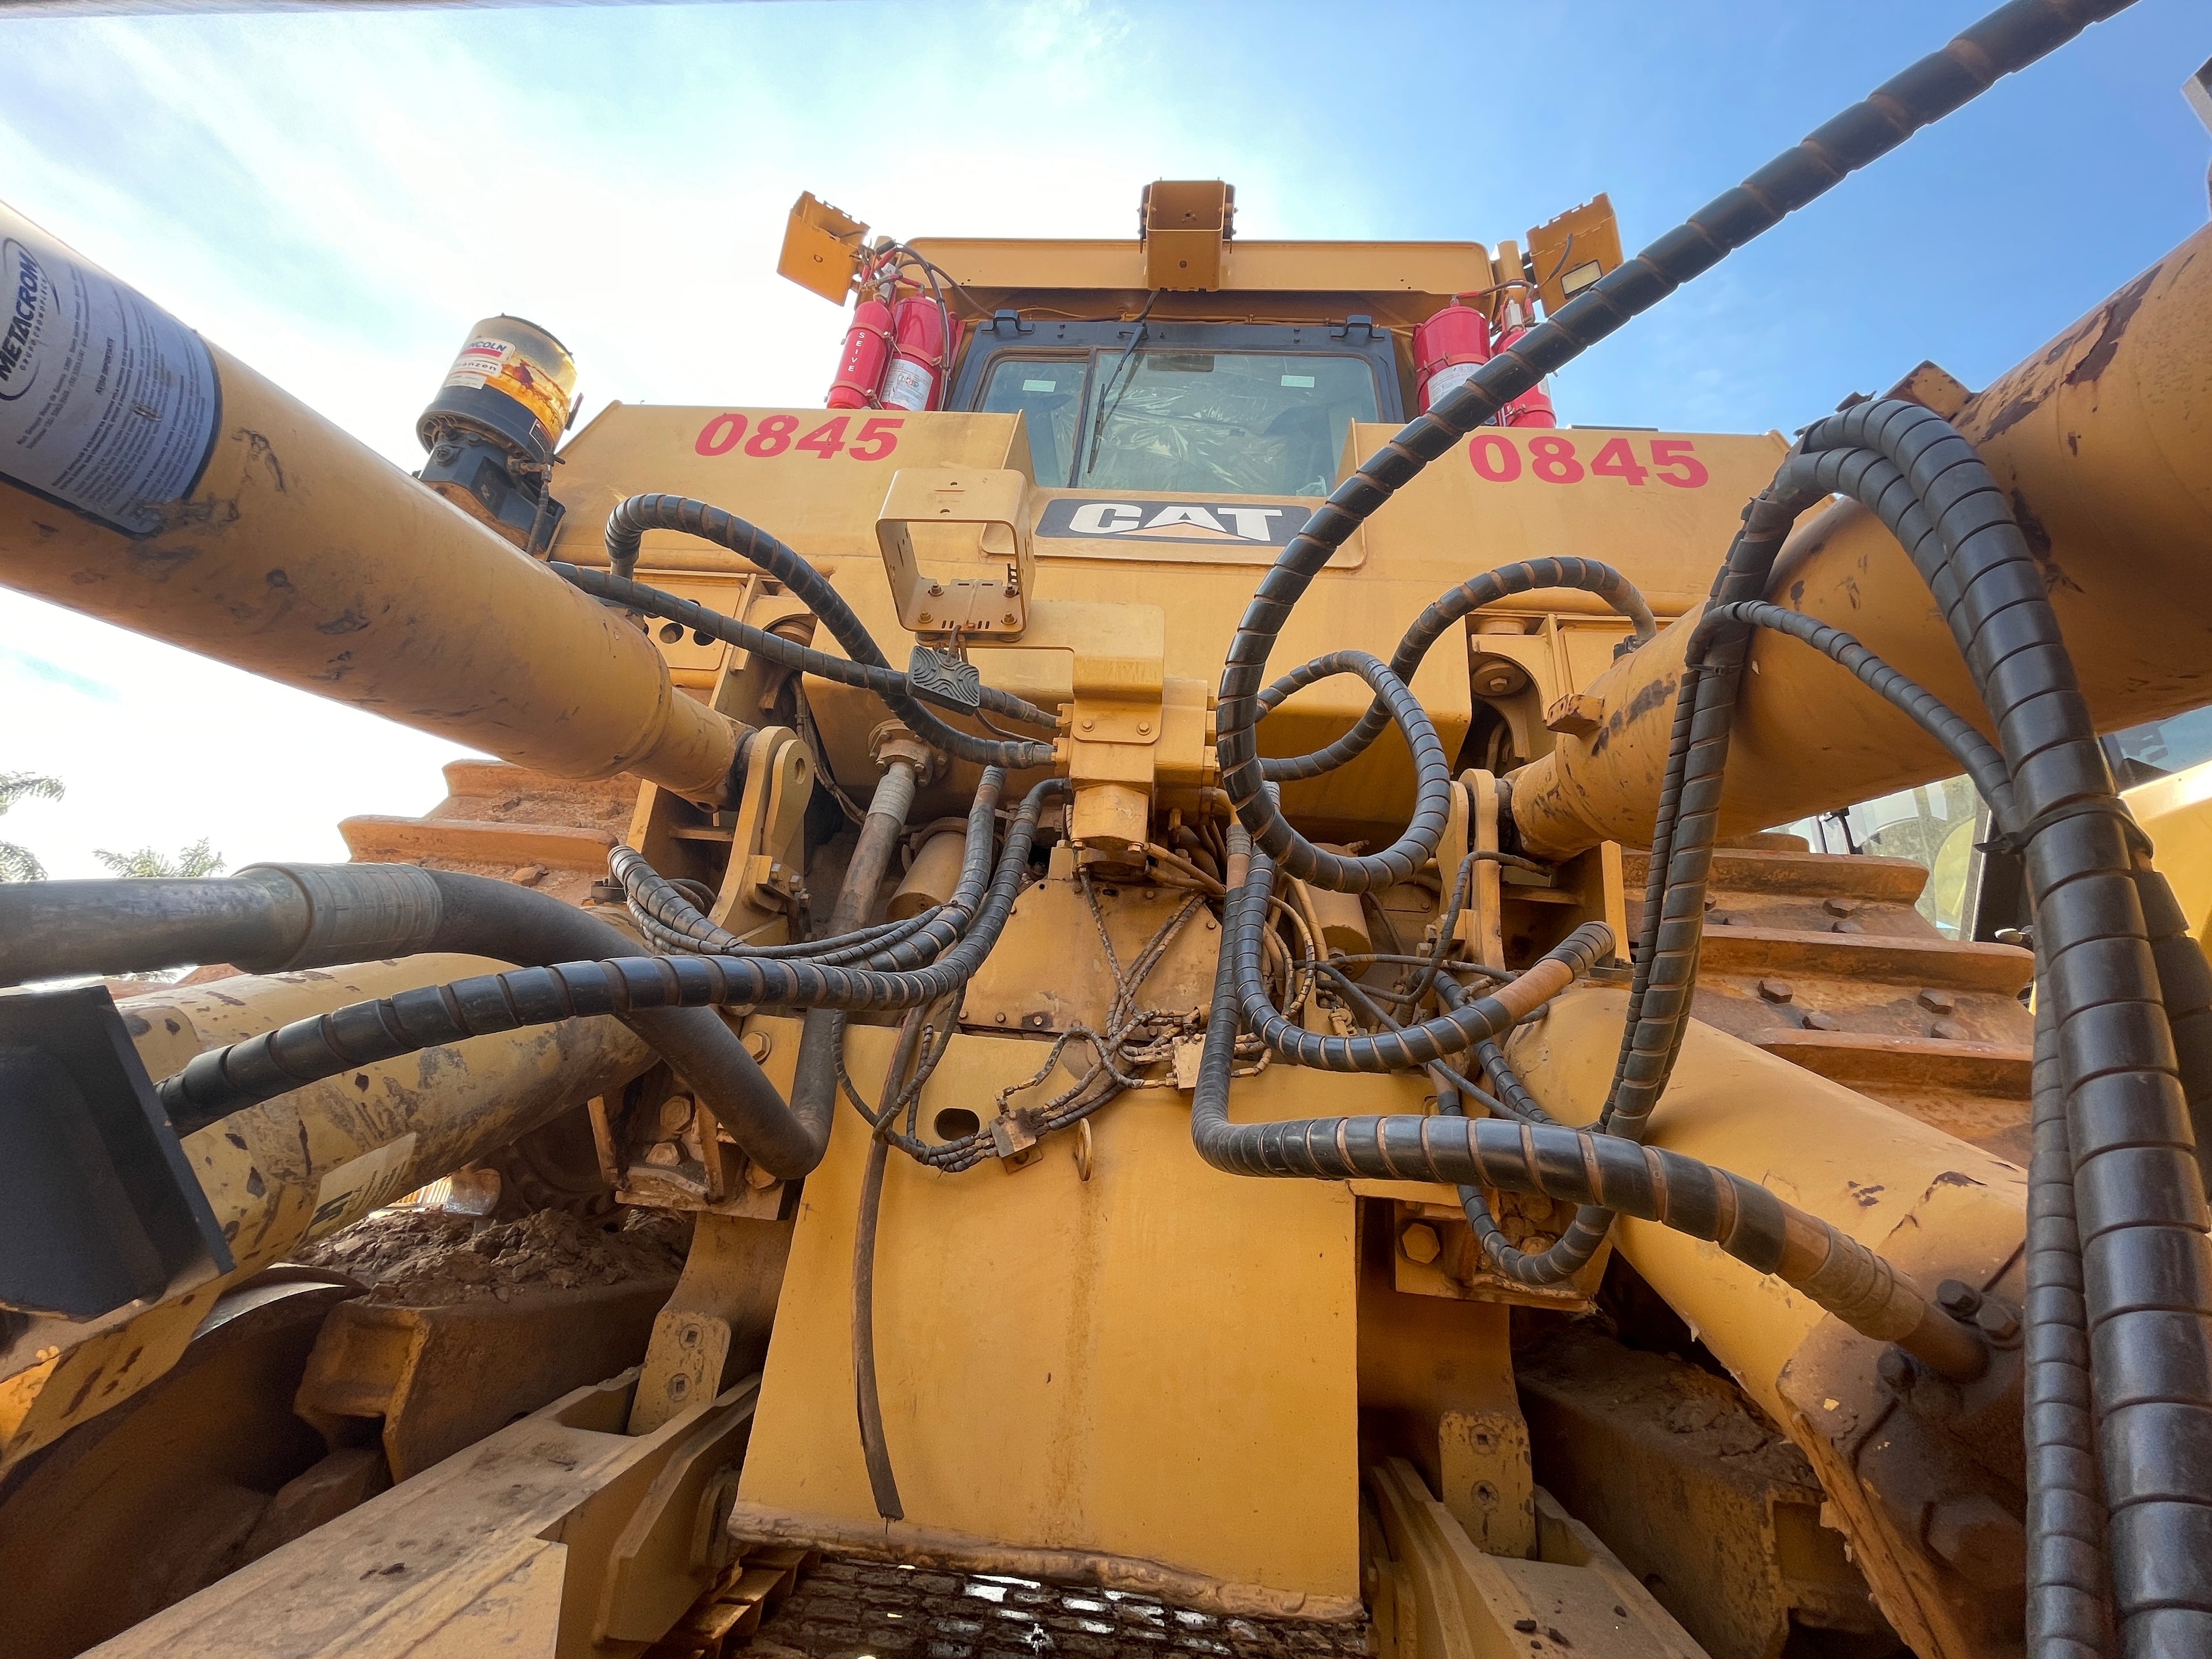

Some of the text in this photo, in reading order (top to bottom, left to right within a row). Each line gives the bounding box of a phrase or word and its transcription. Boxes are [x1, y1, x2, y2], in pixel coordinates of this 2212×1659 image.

[0, 250, 39, 382] METACROM
[847, 331, 866, 372] SEIVE
[695, 413, 904, 461] 0845
[1469, 434, 1708, 488] 0845
[1069, 503, 1283, 541] CAT
